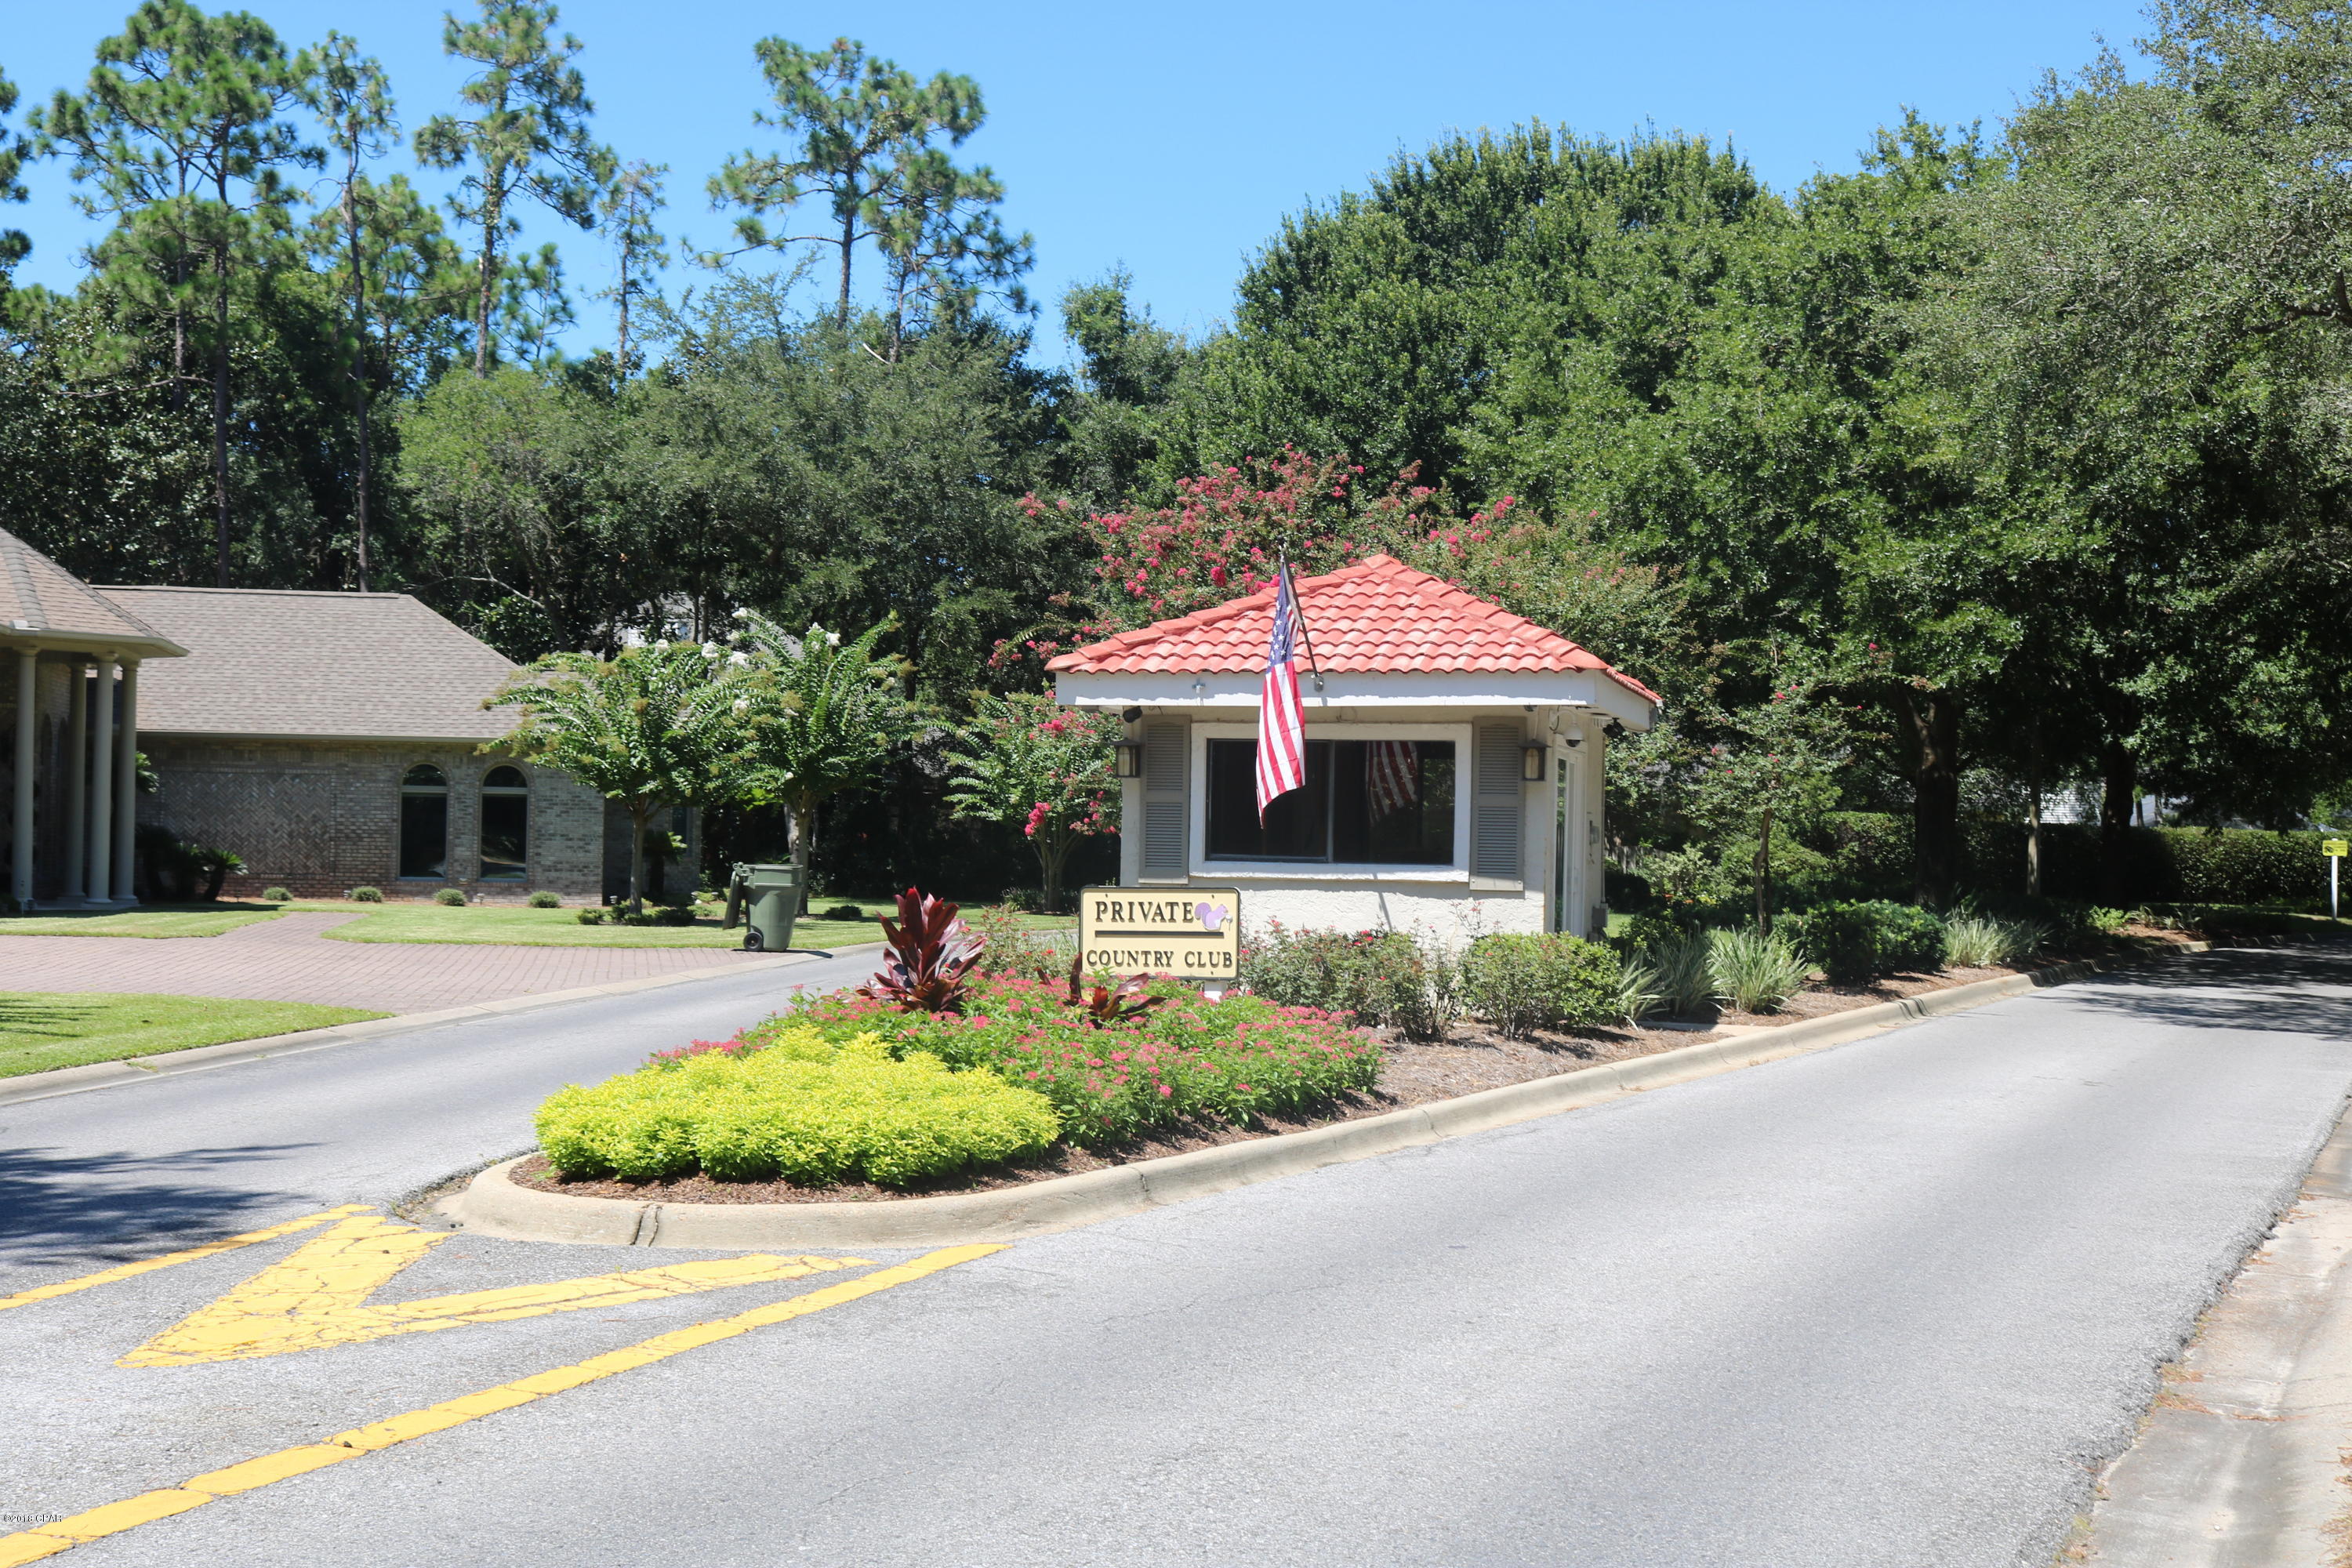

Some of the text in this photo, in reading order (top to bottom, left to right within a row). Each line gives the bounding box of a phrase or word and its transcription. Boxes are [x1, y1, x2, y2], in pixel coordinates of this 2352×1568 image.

[1095, 901, 1194, 923] PRIVATE
[1087, 949, 1232, 968] COUNTRY CLUB
